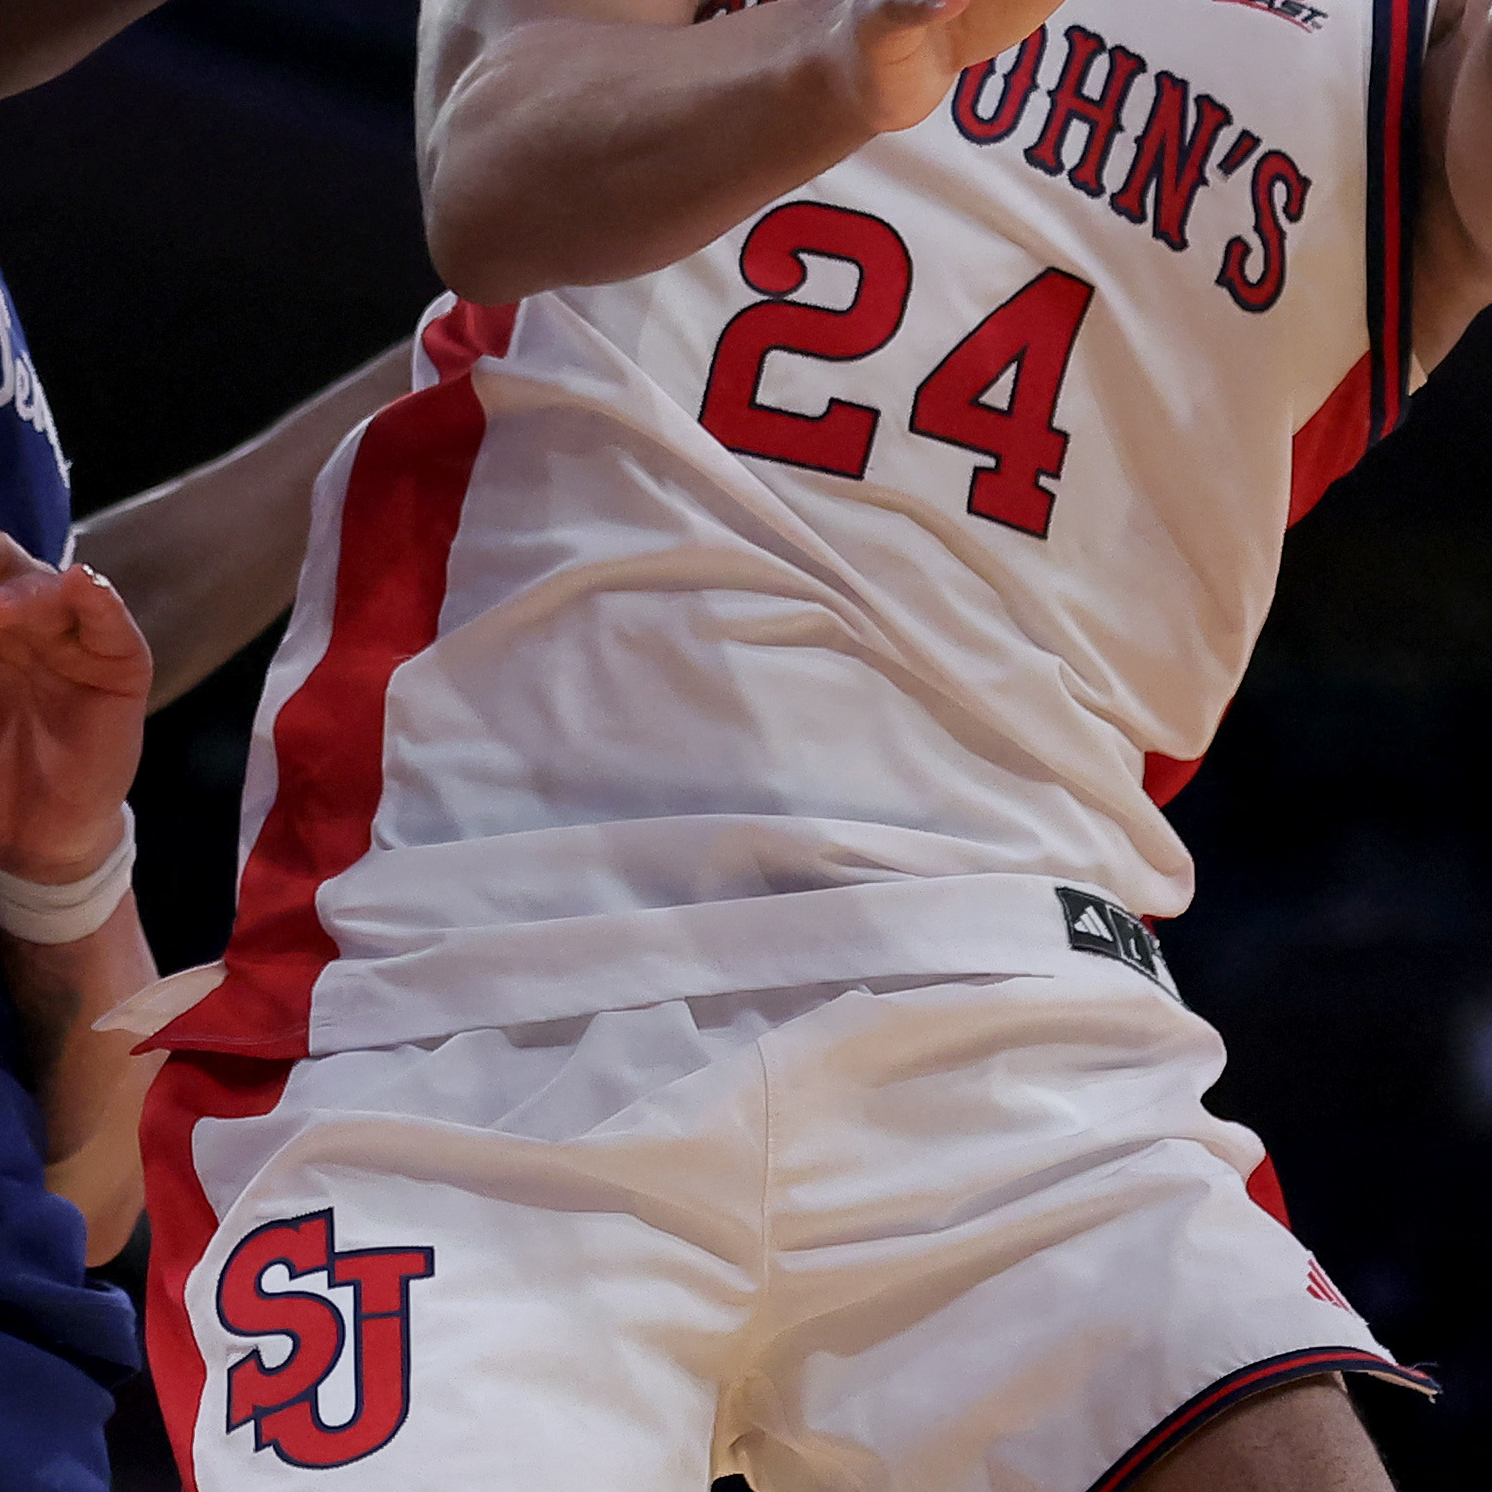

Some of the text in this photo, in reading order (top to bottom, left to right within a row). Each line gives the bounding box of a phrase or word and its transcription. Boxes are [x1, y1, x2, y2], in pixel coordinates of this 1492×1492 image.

[951, 22, 1312, 313] OHN'S
[698, 199, 1095, 539] 24
[215, 1205, 436, 1471] SJ
